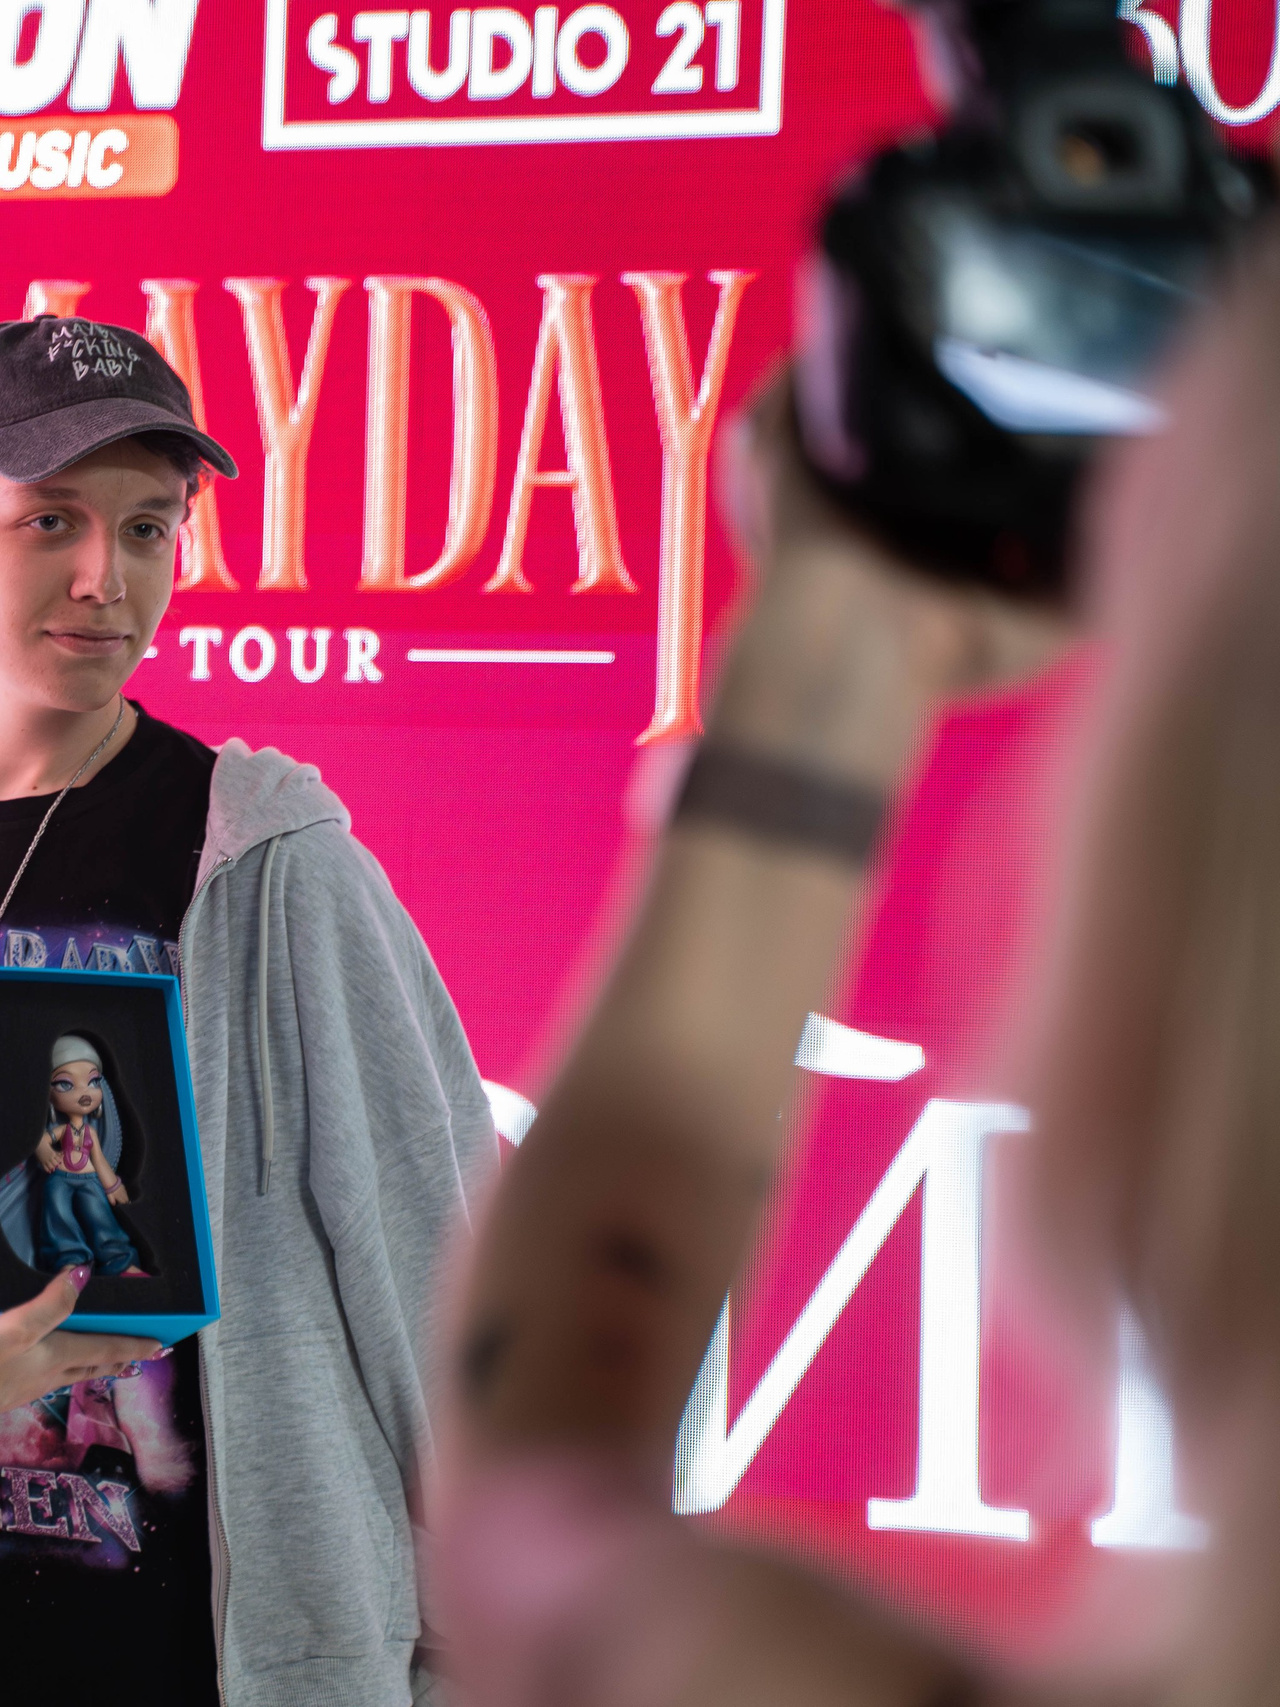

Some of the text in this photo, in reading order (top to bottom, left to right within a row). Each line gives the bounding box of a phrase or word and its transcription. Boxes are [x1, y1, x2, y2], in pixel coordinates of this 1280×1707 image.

[306, 0, 742, 105] STUDIO 21
[72, 357, 133, 382] BABY
[178, 626, 384, 684] TOUR
